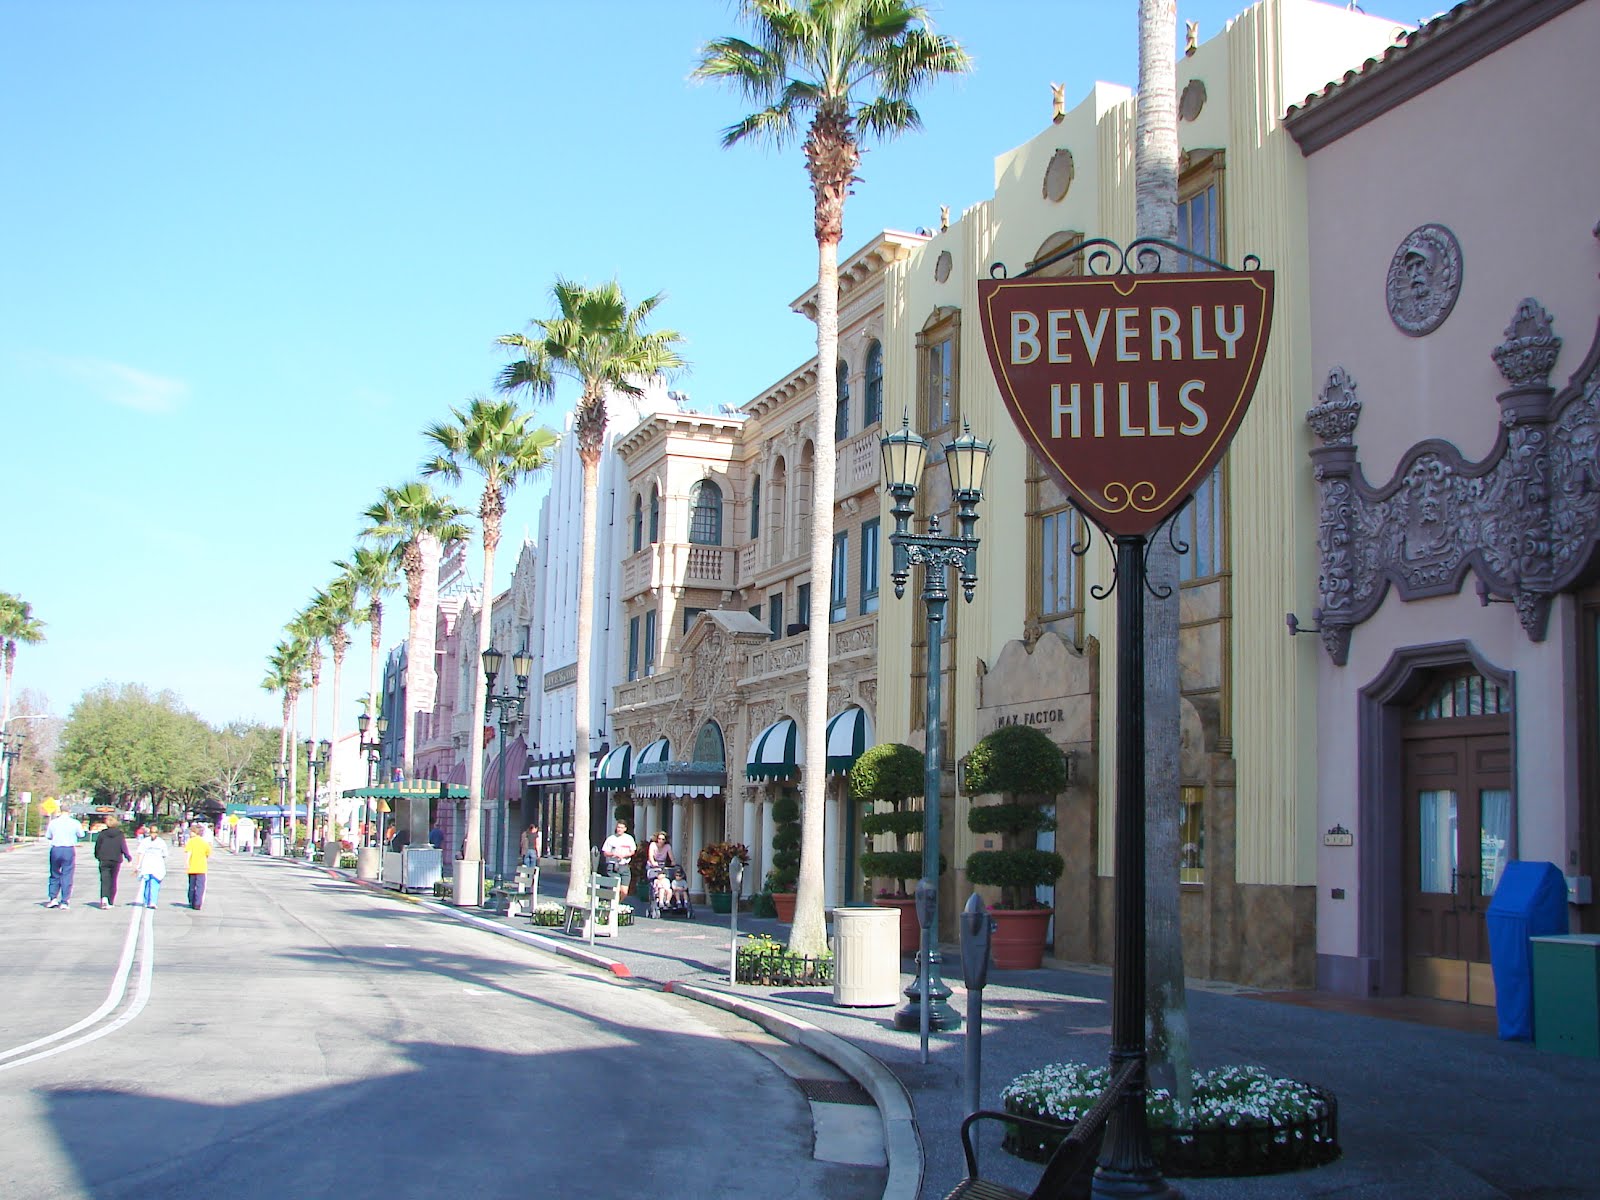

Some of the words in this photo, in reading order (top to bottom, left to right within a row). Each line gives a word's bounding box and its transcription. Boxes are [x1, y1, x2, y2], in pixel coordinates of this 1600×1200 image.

[1010, 304, 1246, 367] BEVERLY
[1050, 380, 1209, 439] HILLS
[998, 715, 1019, 729] MAX
[1024, 709, 1065, 727] FACTOR
